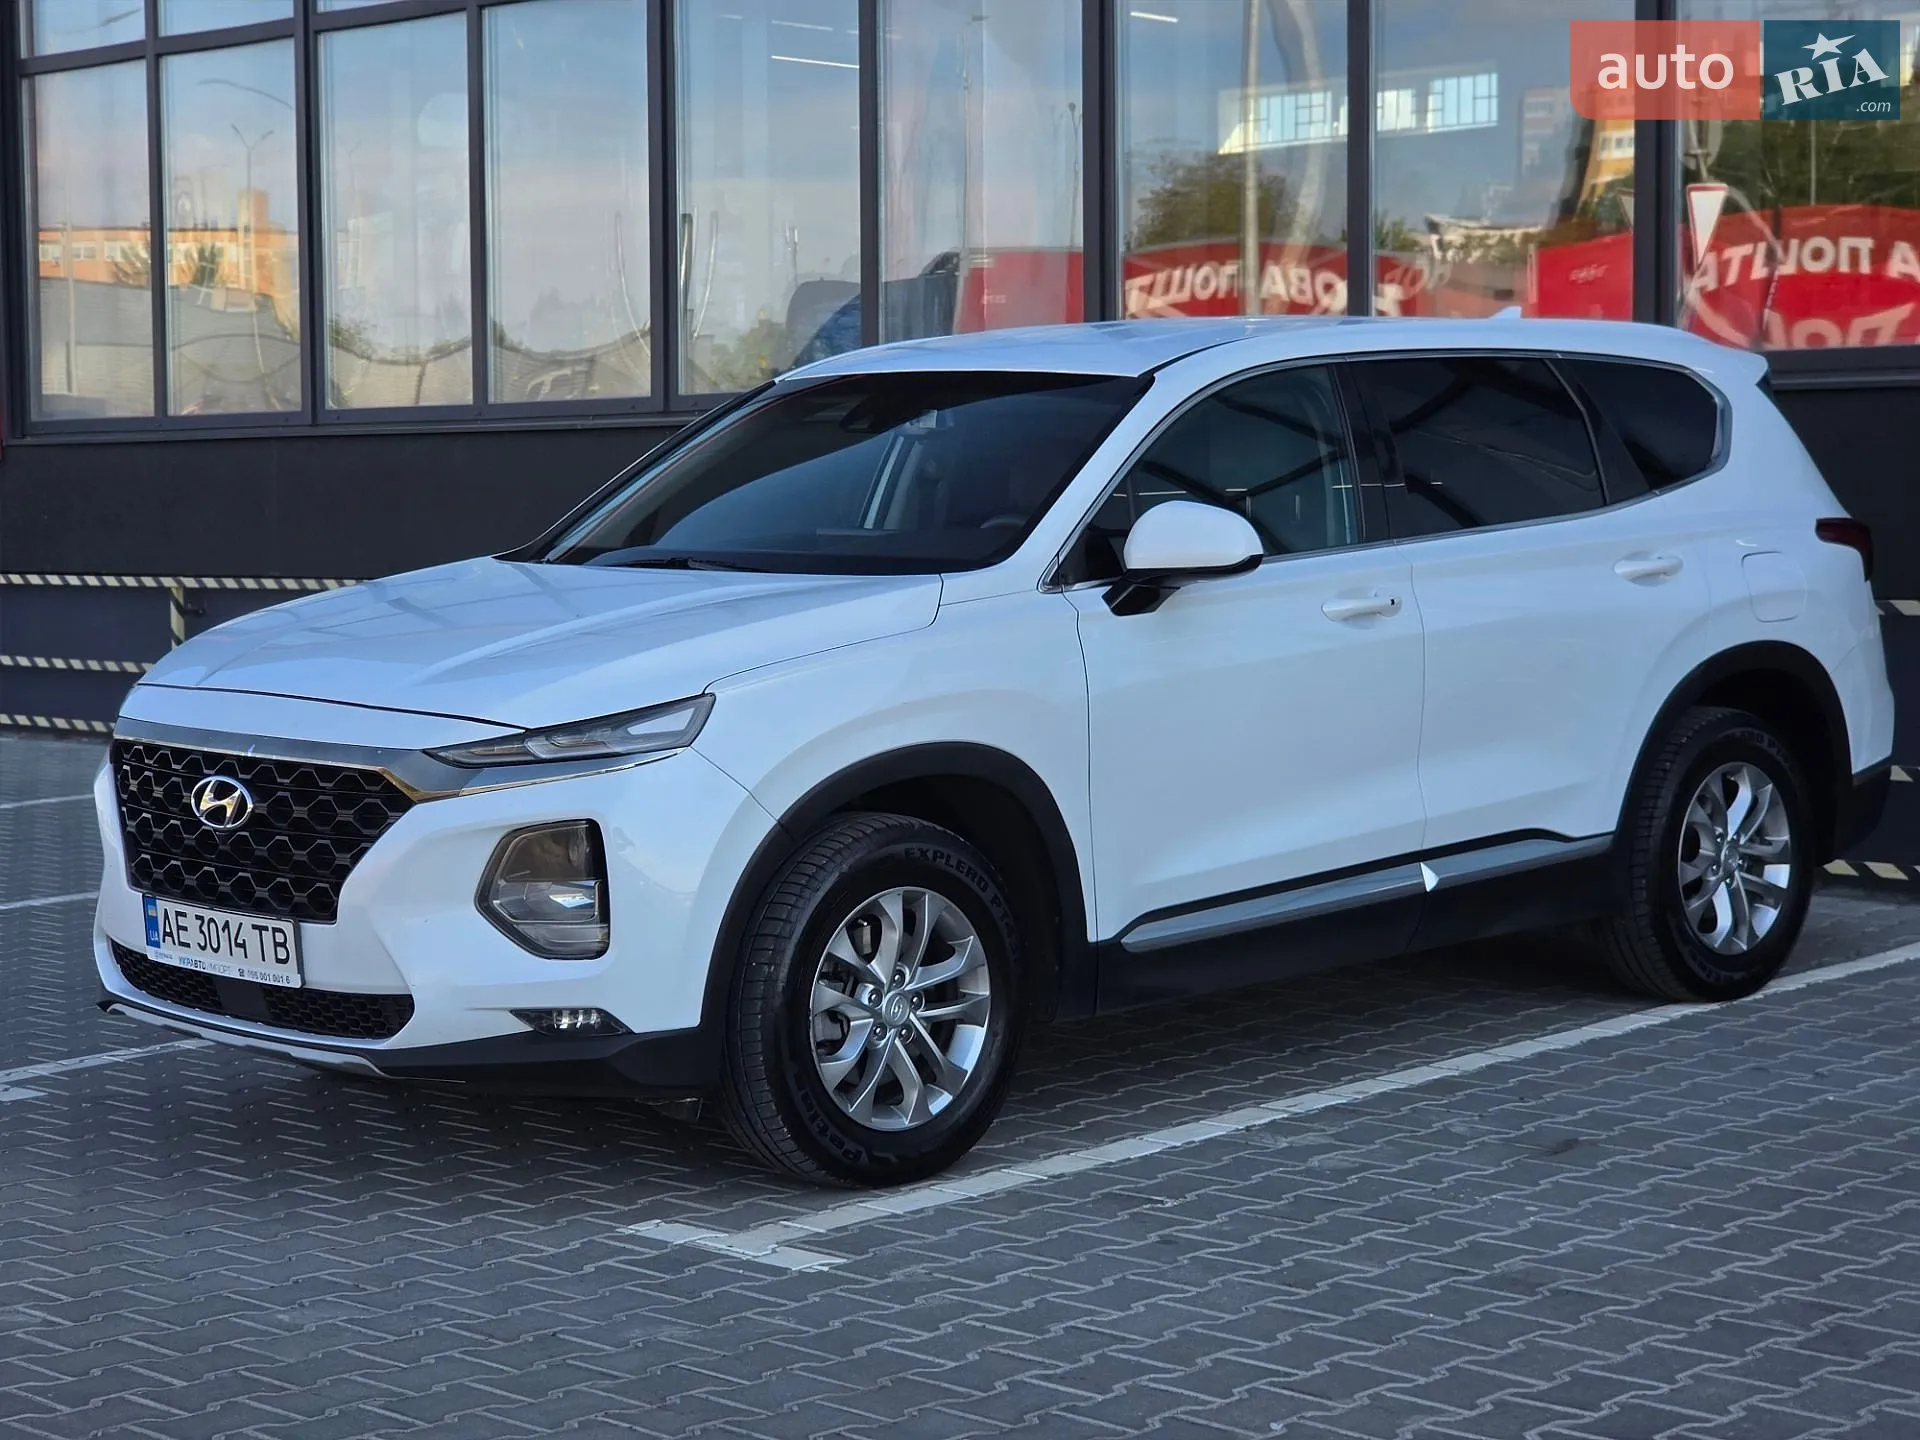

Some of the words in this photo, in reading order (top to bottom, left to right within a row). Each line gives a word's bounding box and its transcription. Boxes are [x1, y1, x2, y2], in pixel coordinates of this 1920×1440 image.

[904, 847, 990, 893] EXPLERO
[162, 908, 191, 948] AE
[194, 914, 248, 959] 3014
[251, 924, 291, 965] TB
